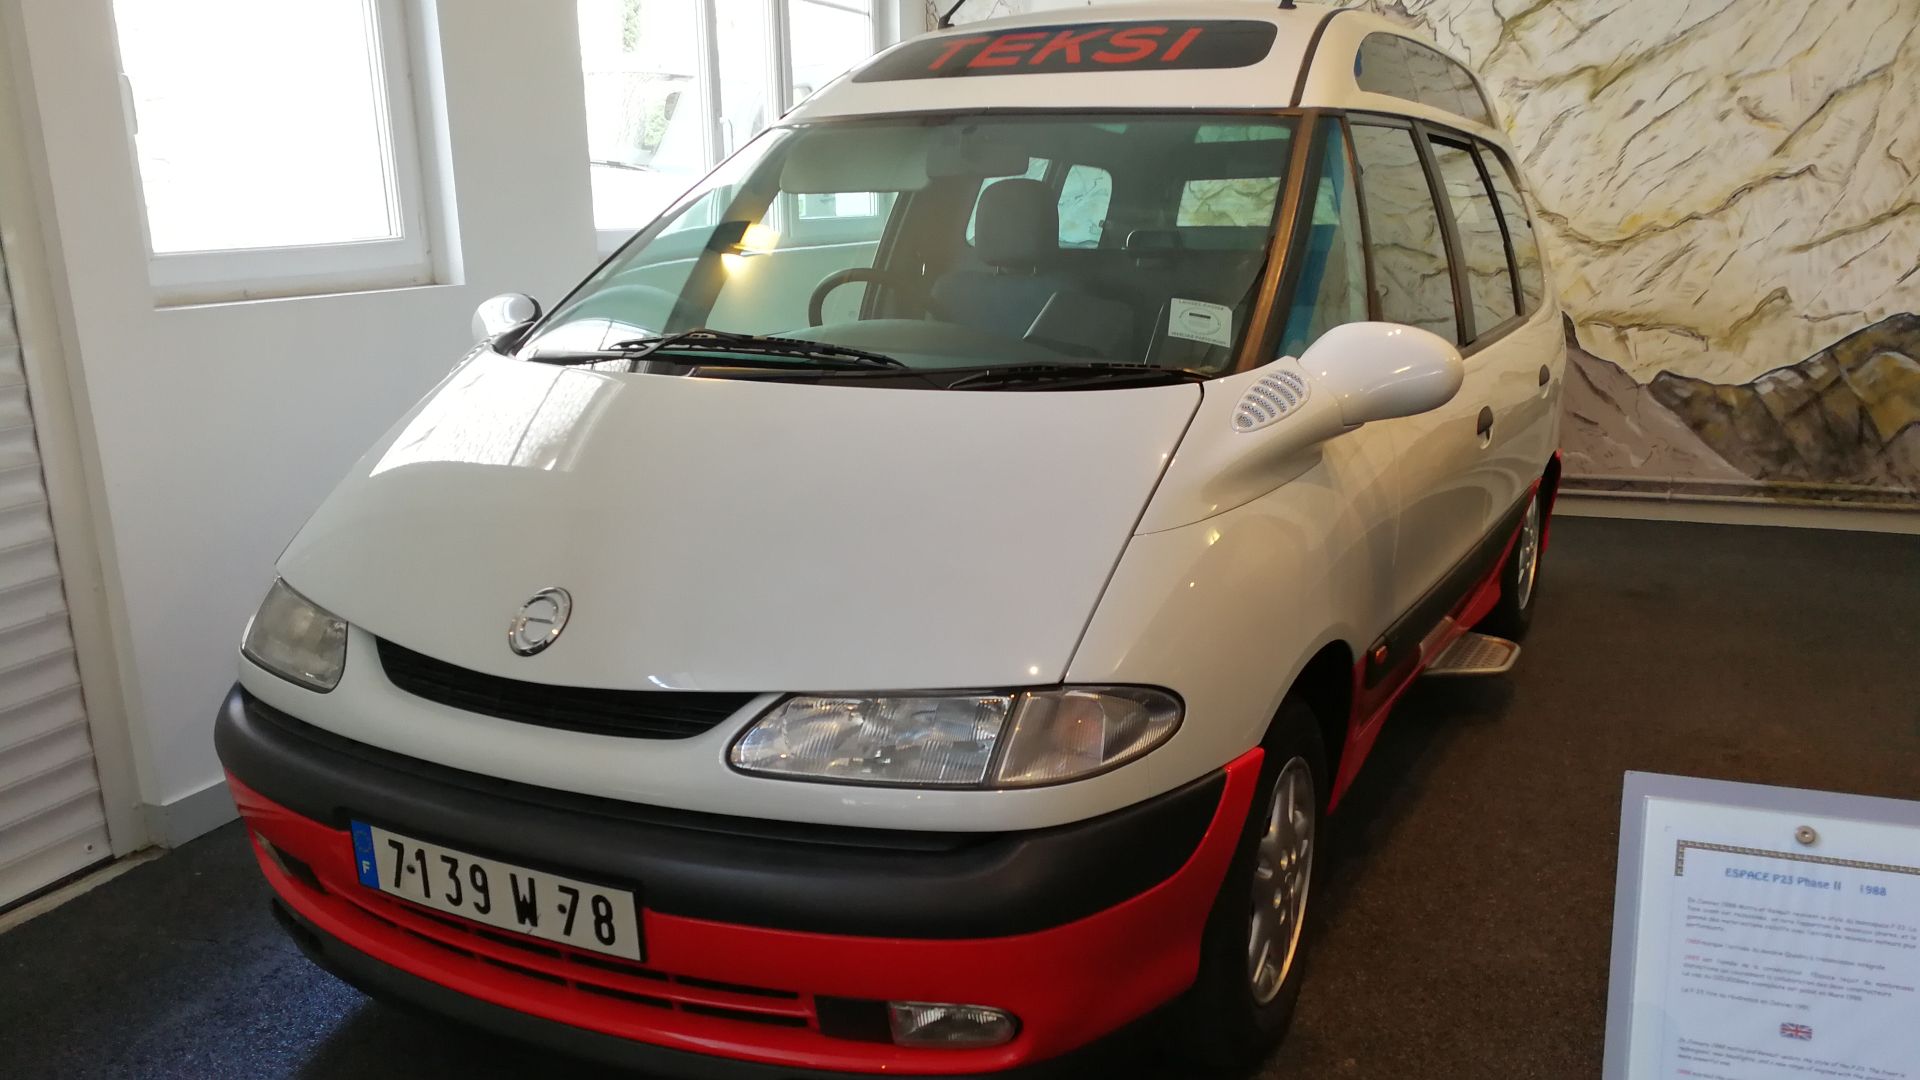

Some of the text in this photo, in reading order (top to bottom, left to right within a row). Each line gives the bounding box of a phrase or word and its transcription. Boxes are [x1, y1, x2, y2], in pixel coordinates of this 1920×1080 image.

[928, 26, 1203, 71] TEKSI
[361, 860, 371, 875] F
[1725, 867, 1769, 882] ESPACE
[1797, 876, 1830, 890] Phase
[1860, 884, 1887, 896] 1988
[510, 873, 538, 927] W
[558, 885, 616, 946] 78
